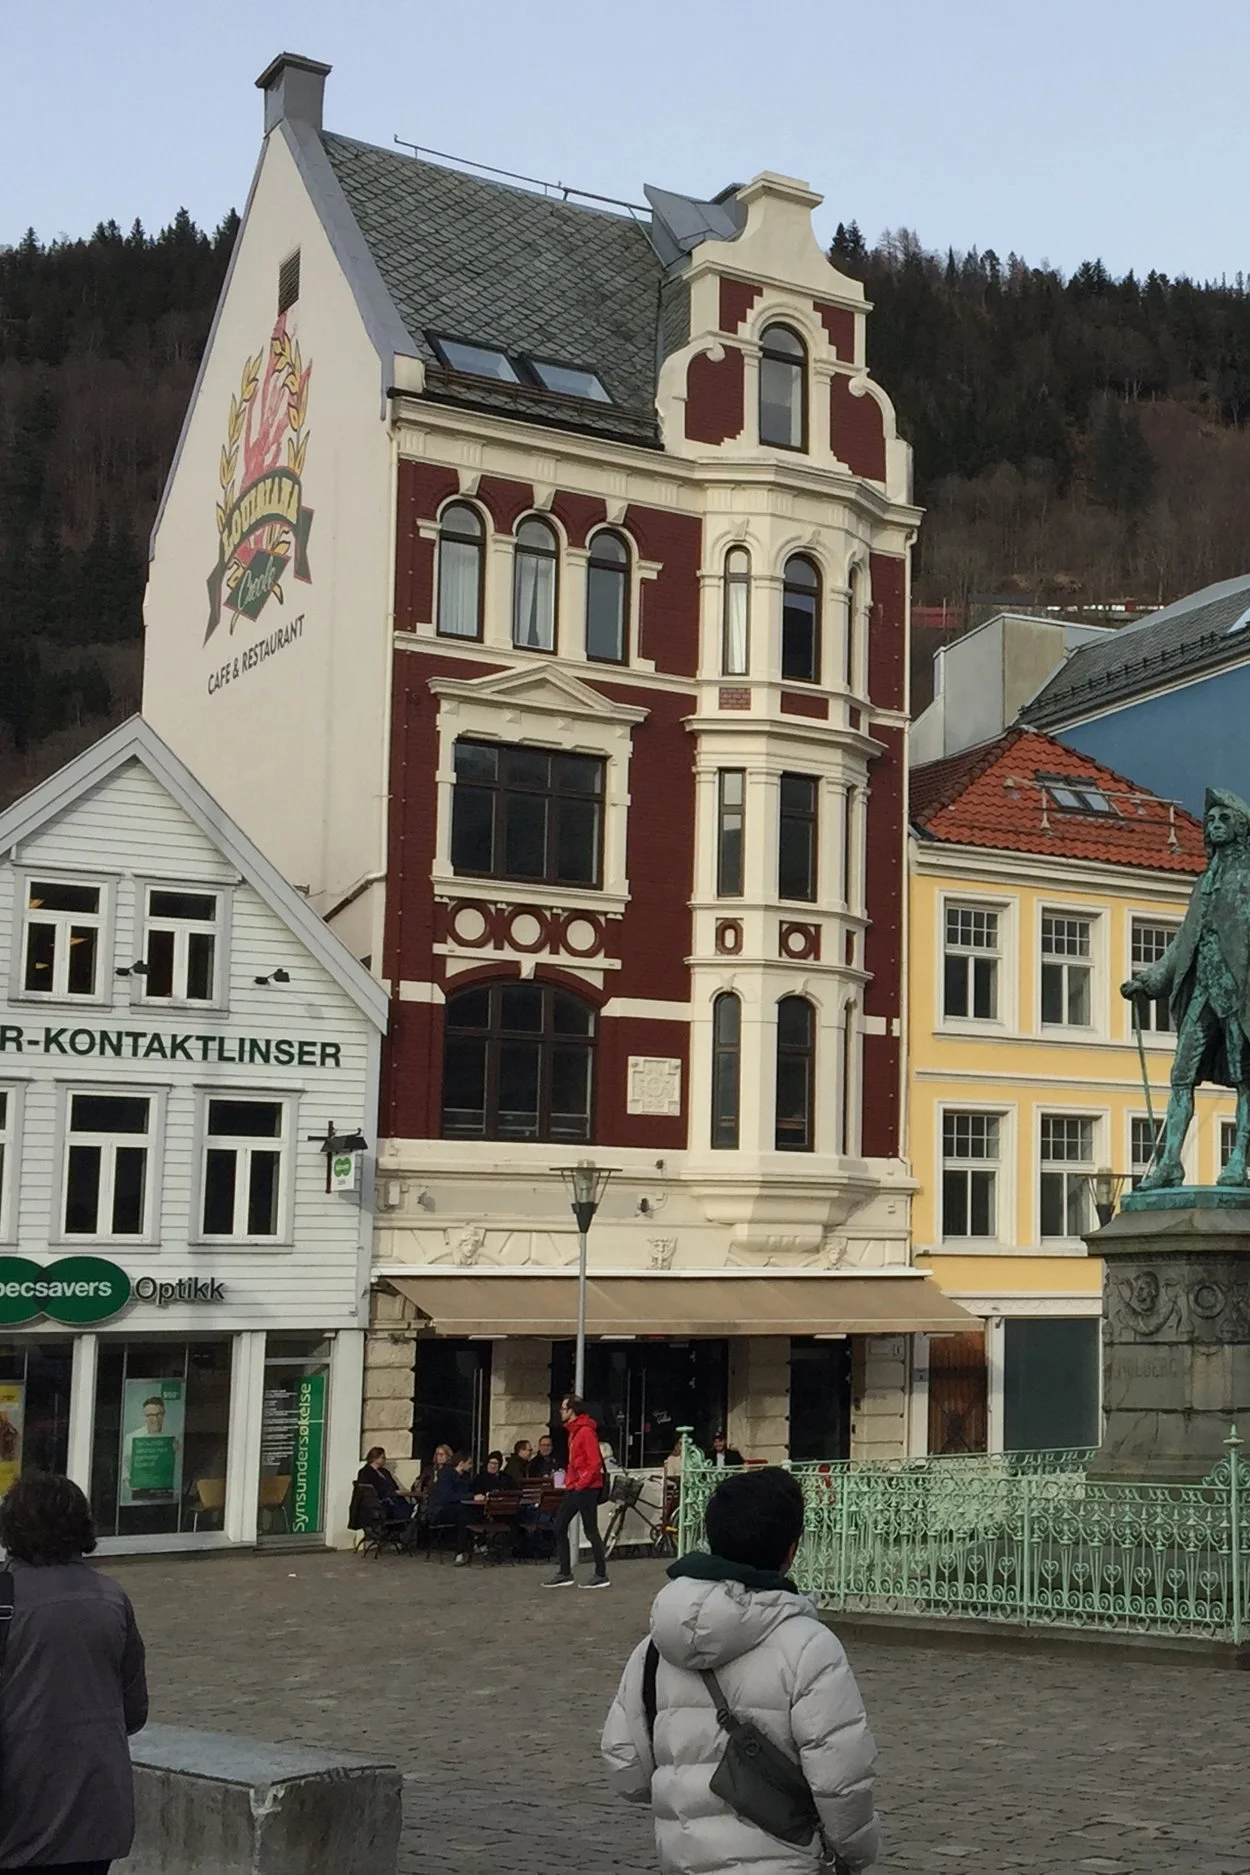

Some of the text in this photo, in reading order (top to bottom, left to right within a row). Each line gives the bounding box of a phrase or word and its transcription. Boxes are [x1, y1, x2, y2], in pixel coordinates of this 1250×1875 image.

[207, 661, 231, 695] CAFE
[242, 613, 305, 672] RESTAURANT
[0, 1024, 342, 1067] R-KONTAKTLINSER
[135, 1276, 225, 1304] Optikk
[292, 1382, 312, 1533] Synsundersøkelse
